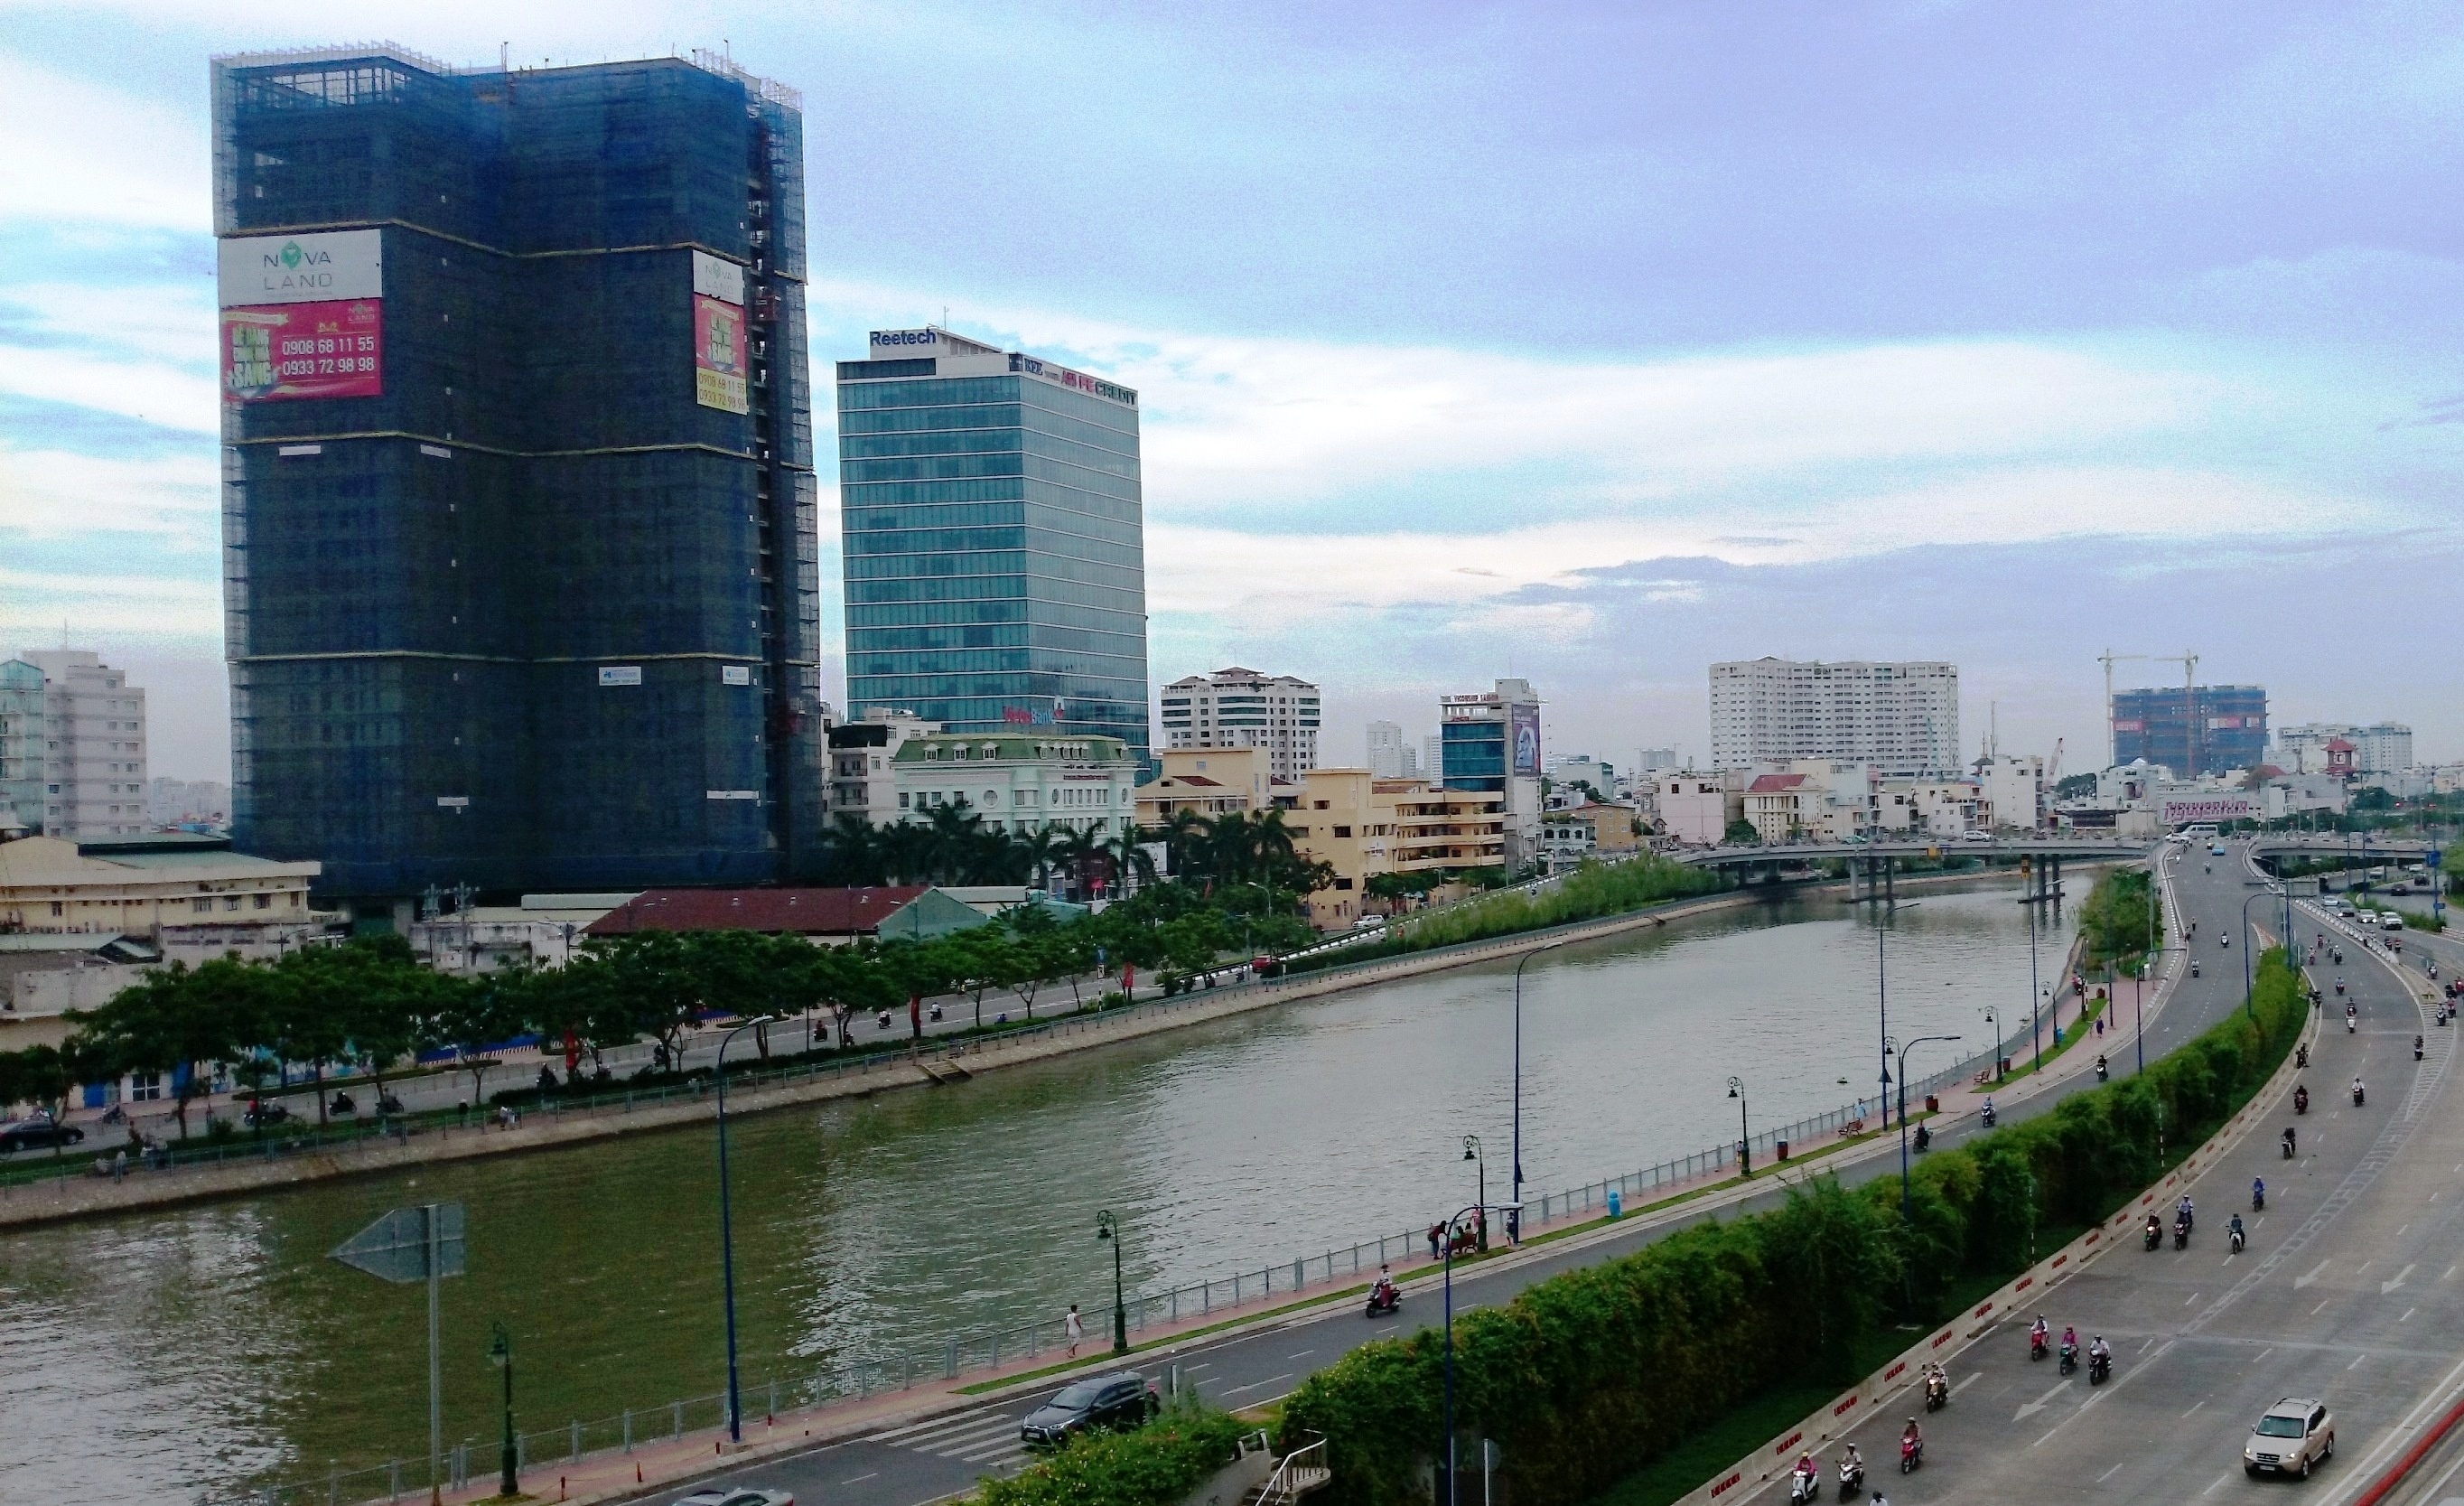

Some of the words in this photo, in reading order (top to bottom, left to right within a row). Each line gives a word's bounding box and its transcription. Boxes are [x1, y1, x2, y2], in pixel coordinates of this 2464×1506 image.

[264, 240, 331, 269] NOVA
[264, 273, 332, 290] LAND
[282, 340, 314, 356] 0908
[318, 338, 333, 354] 68
[339, 338, 352, 352] 11
[358, 336, 375, 351] 55
[870, 329, 936, 347] Reetech
[282, 360, 314, 376] 0933
[318, 359, 334, 374] 72
[339, 357, 354, 373] 98
[358, 356, 375, 371] 98
